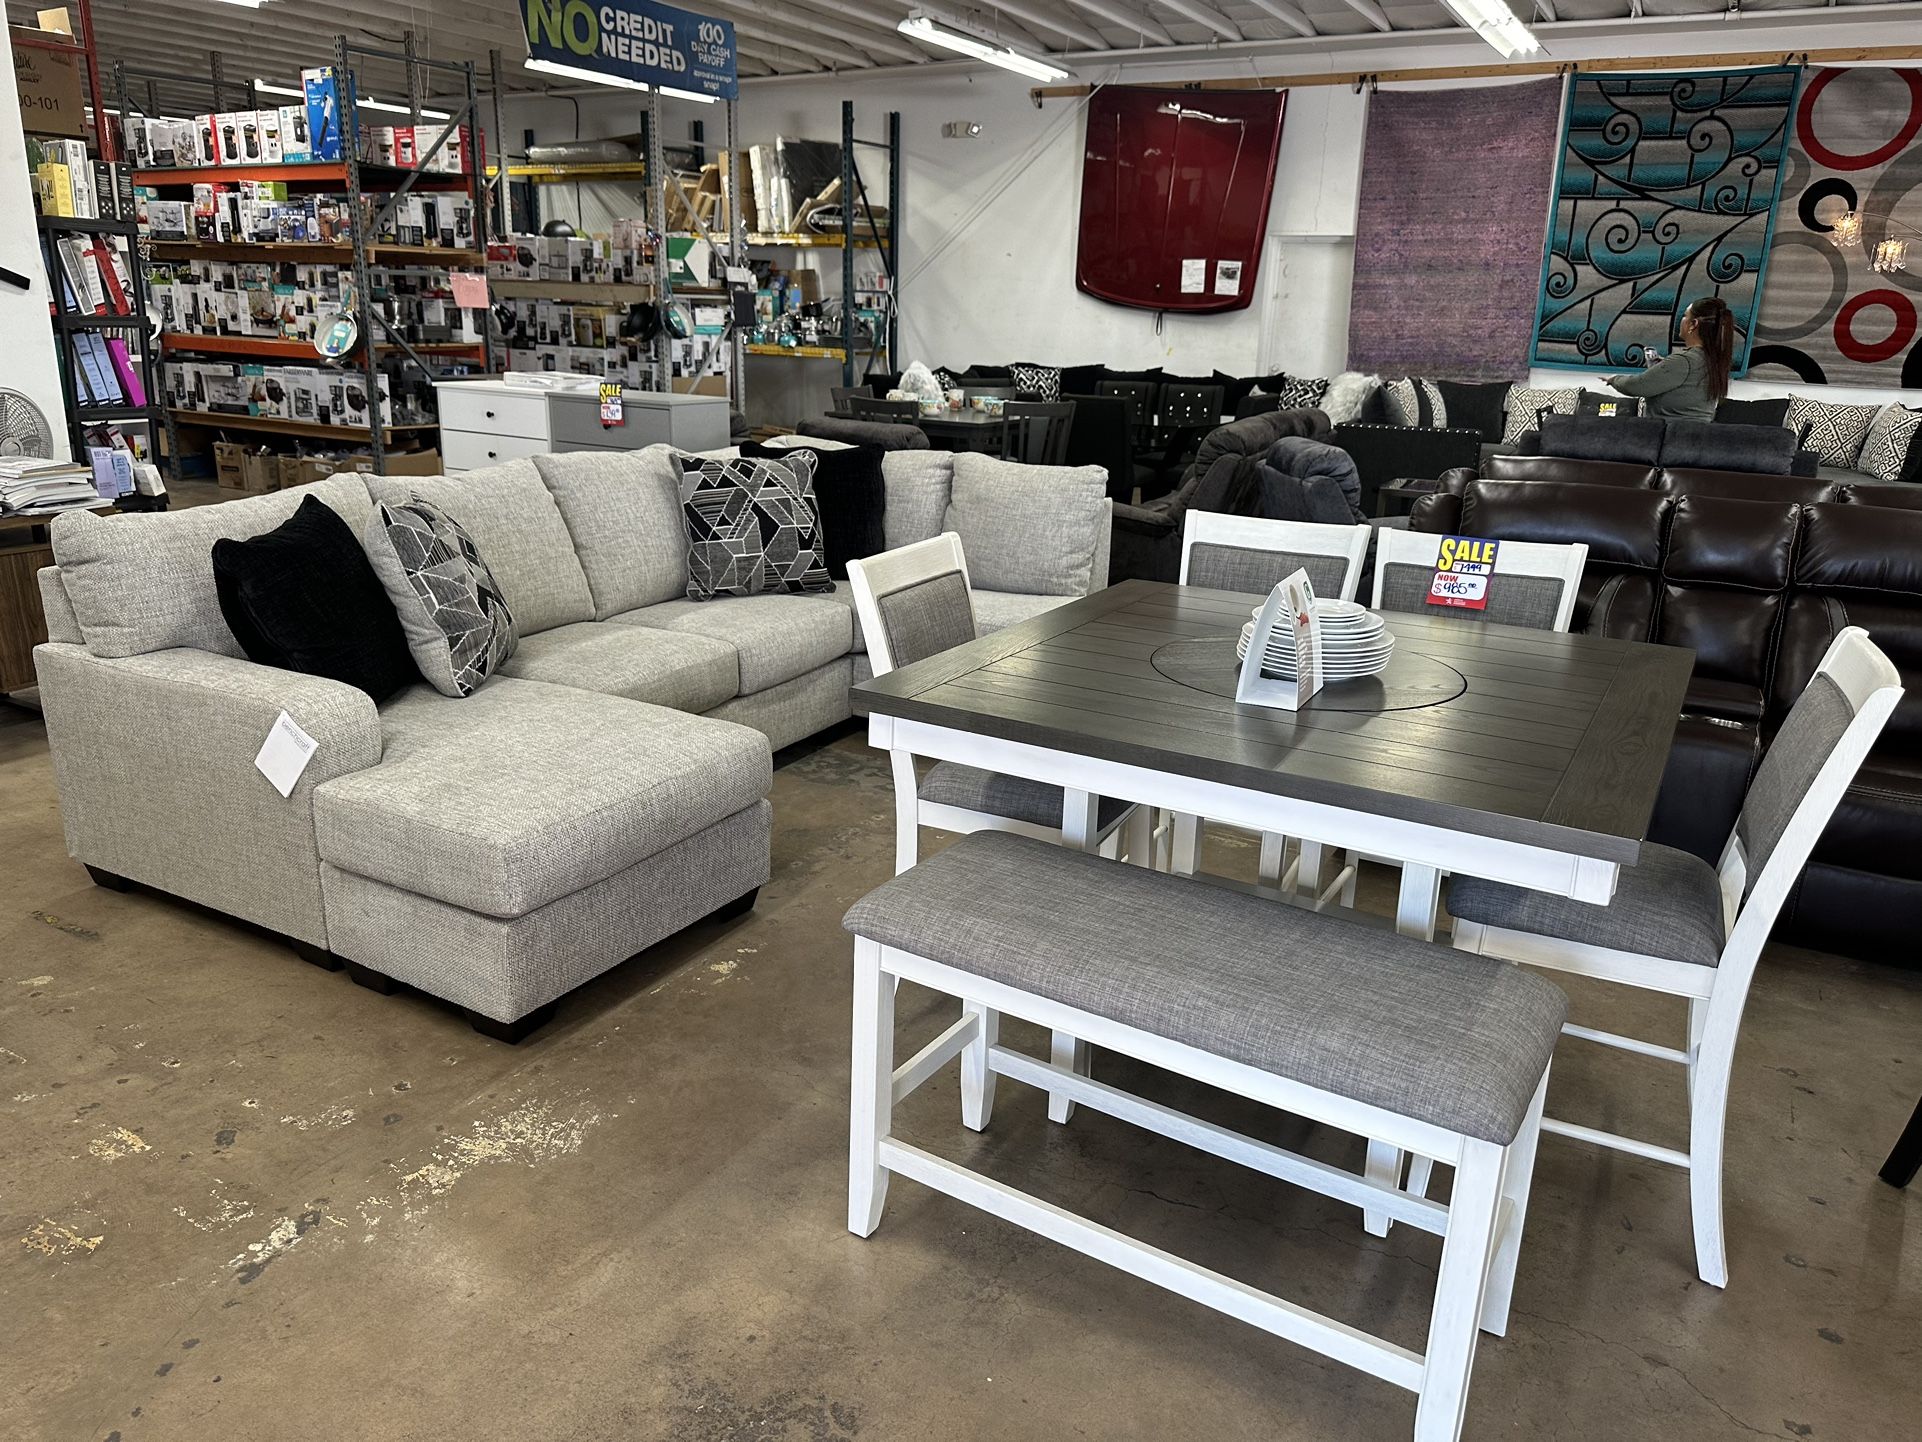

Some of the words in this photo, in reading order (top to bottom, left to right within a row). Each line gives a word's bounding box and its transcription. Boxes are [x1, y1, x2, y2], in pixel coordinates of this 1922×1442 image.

[527, 0, 599, 56] NO
[600, 5, 674, 46] CREDIT
[698, 21, 725, 45] 100
[600, 33, 687, 73] NEEDED
[691, 41, 708, 53] DAY
[710, 45, 731, 59] CASH
[698, 52, 725, 67] PAYOFF
[600, 383, 622, 404] SALE
[1600, 403, 1616, 412] SALE
[1438, 538, 1495, 570] SALE
[1437, 573, 1459, 582] NOW
